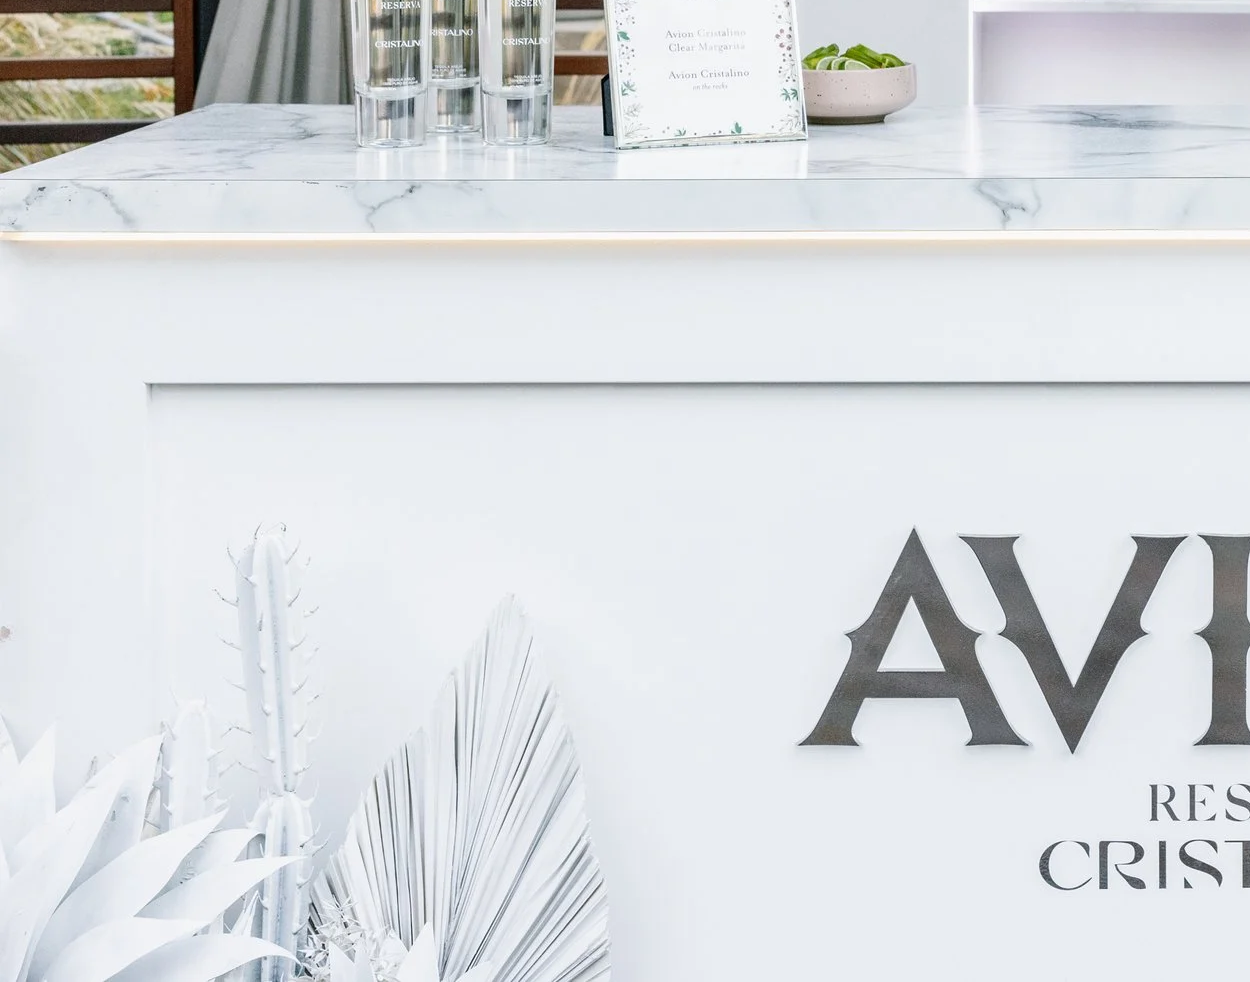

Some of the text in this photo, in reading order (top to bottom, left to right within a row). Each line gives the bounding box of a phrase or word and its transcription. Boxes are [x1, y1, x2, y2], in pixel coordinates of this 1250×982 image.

[381, 1, 421, 9] RESERVA
[431, 28, 474, 37] RISTALINO
[665, 29, 694, 39] Avion
[668, 42, 694, 52] Clear
[668, 68, 750, 79] Avion Cristalino
